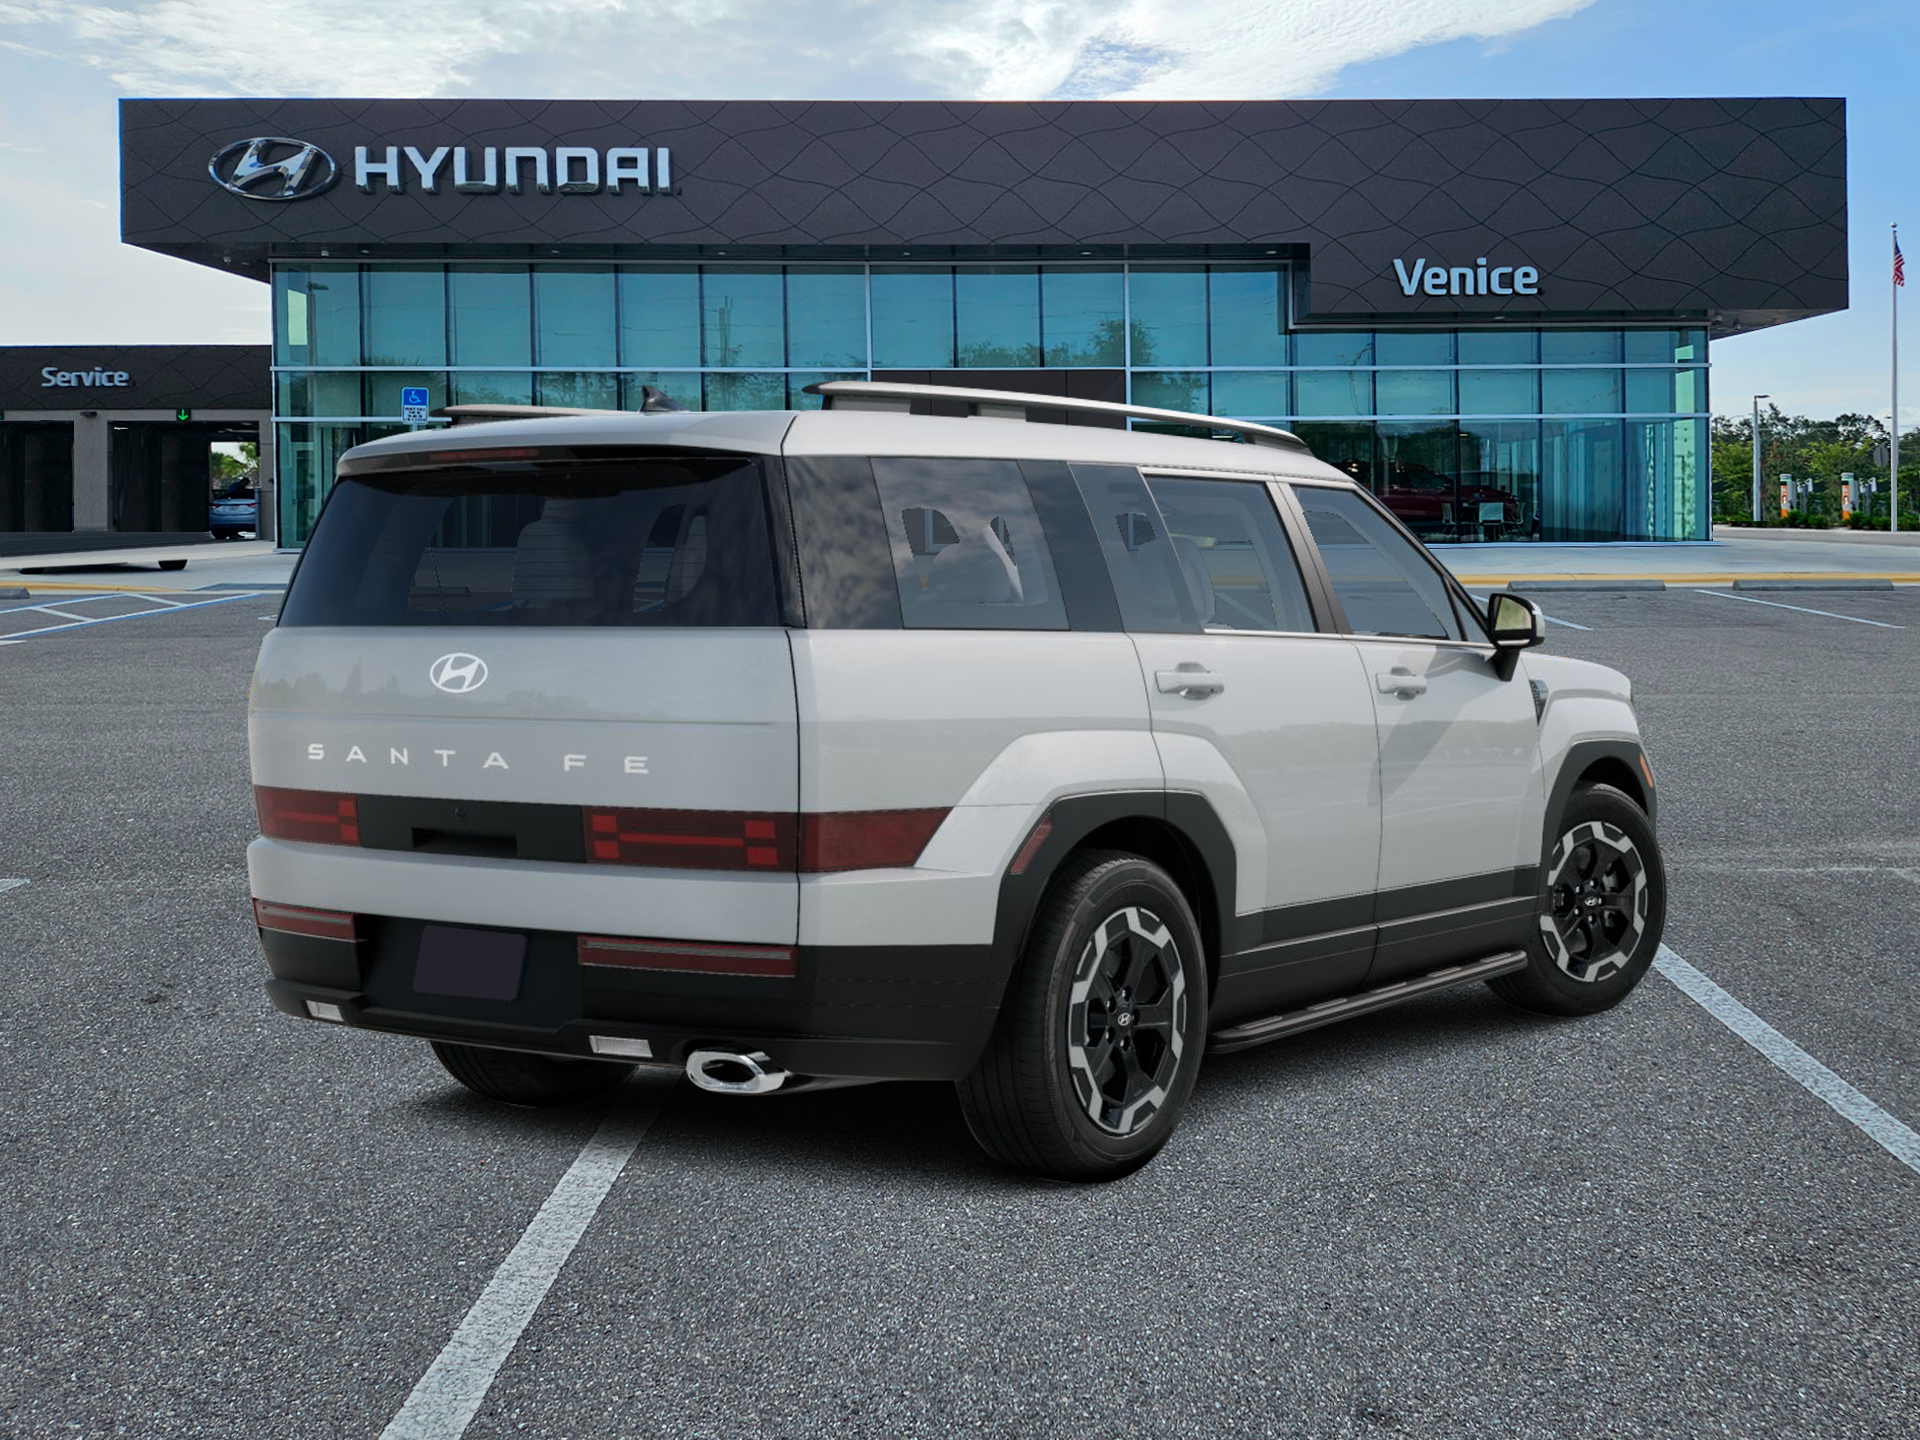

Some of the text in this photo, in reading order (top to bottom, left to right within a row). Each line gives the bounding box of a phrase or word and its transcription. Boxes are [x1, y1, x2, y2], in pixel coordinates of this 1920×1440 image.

[354, 146, 672, 194] HYUNDAI
[1393, 257, 1539, 296] Venice
[41, 366, 130, 387] Service
[307, 743, 649, 774] SANTA FE
